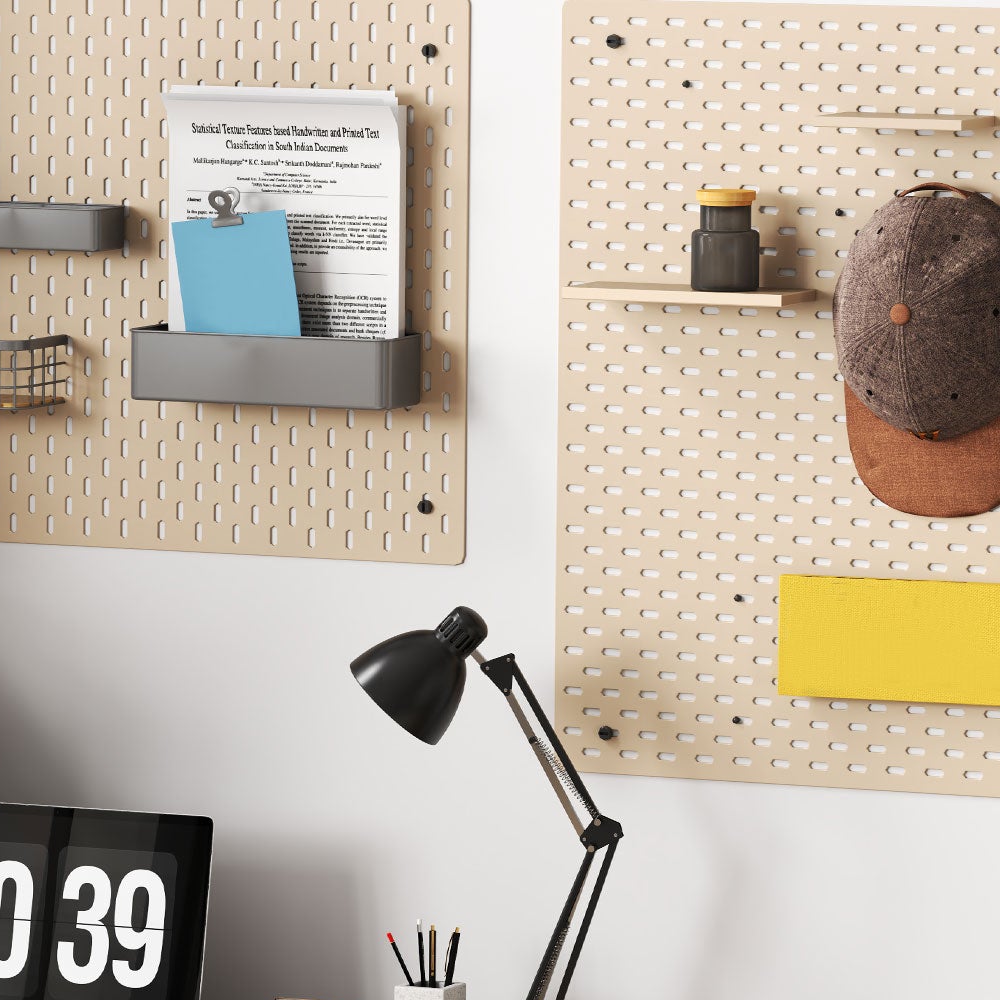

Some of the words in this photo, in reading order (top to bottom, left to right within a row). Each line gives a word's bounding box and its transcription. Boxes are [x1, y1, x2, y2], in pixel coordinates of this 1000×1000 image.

[192, 123, 221, 134] Statistical
[222, 124, 245, 134] Texture
[247, 125, 272, 135] Features
[273, 125, 290, 136] based
[291, 126, 328, 137] Handwritten
[330, 127, 341, 137] and
[342, 128, 364, 138] Printed
[365, 128, 379, 138] Text
[226, 140, 266, 150] Classification
[268, 141, 274, 150] in
[276, 142, 292, 150] South
[294, 142, 313, 151] Indian
[314, 143, 348, 152] Documents
[56, 865, 166, 988] 39
